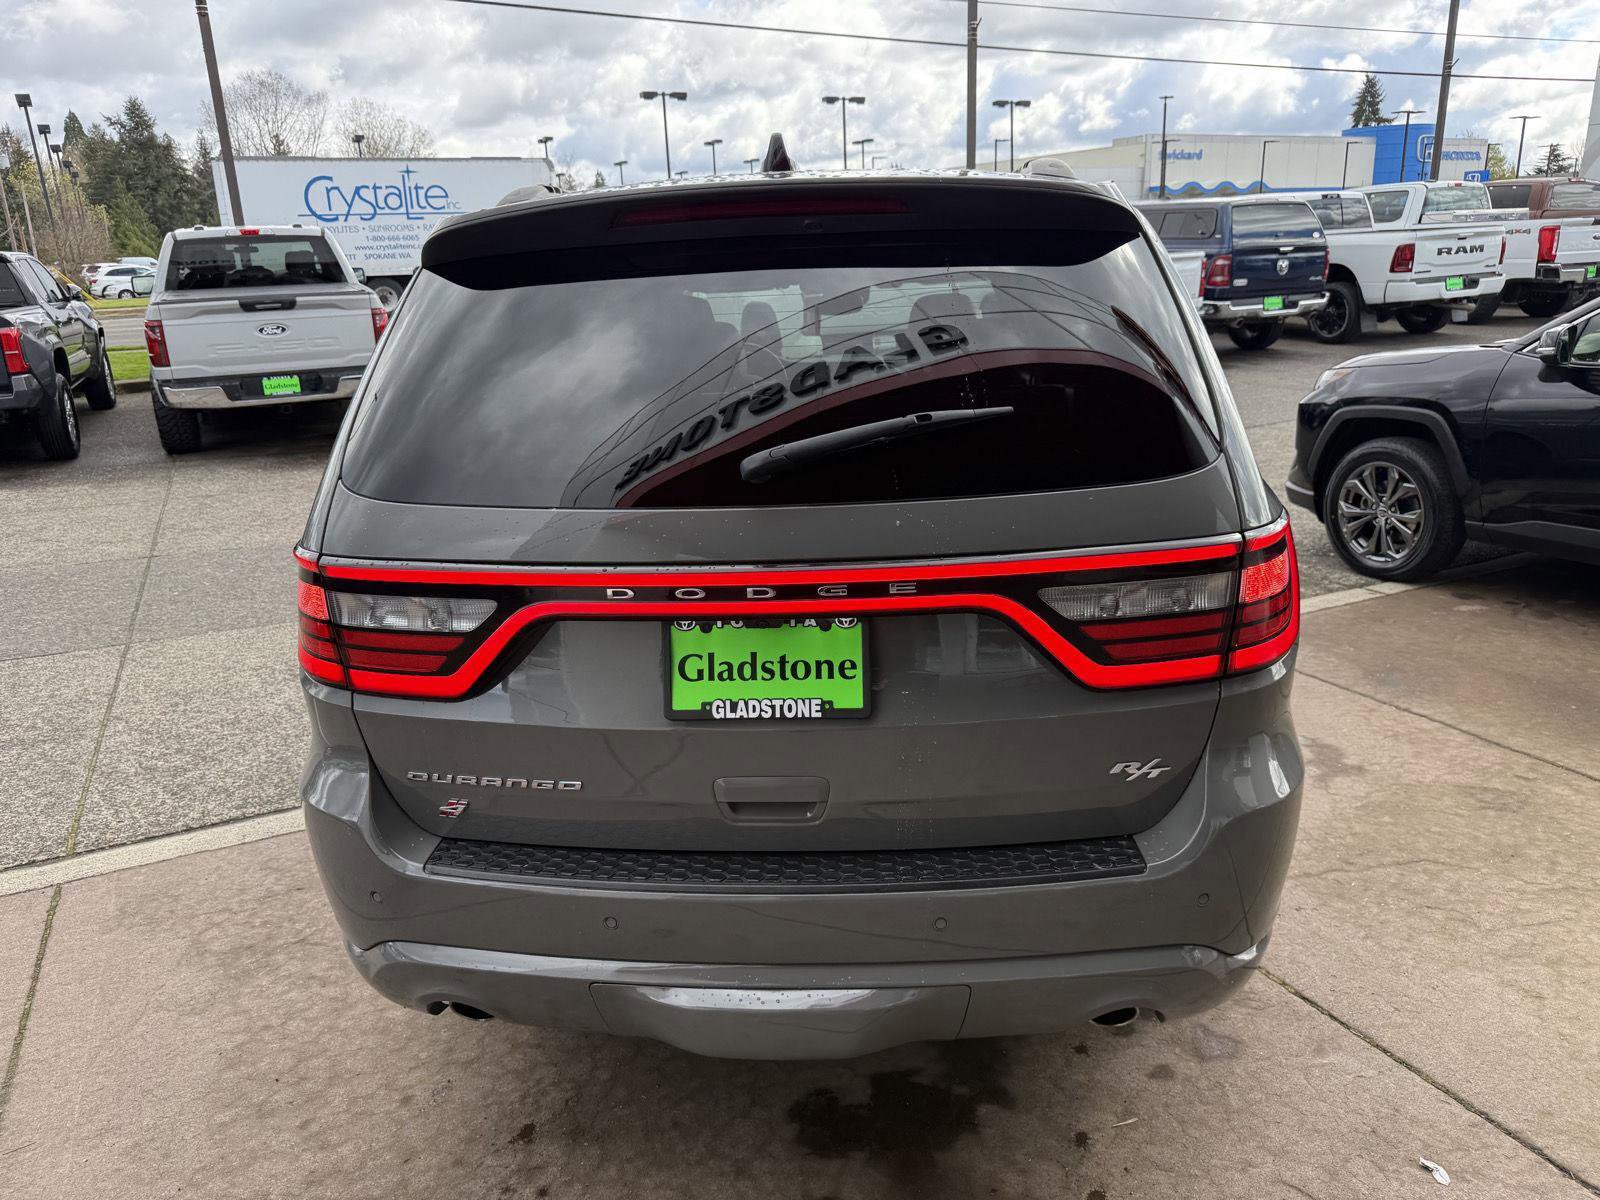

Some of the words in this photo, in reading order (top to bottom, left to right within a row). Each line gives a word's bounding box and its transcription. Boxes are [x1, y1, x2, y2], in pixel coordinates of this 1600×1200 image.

[1158, 148, 1203, 160] wickard
[327, 224, 360, 234] KYLITES
[368, 223, 415, 233] SUNROOMS
[1437, 244, 1485, 256] RAM
[607, 582, 917, 599] DODGE
[677, 651, 858, 682] Gladstone
[711, 699, 822, 719] GLADSTONE
[1109, 758, 1172, 781] R/T
[407, 771, 583, 790] DURANGO
